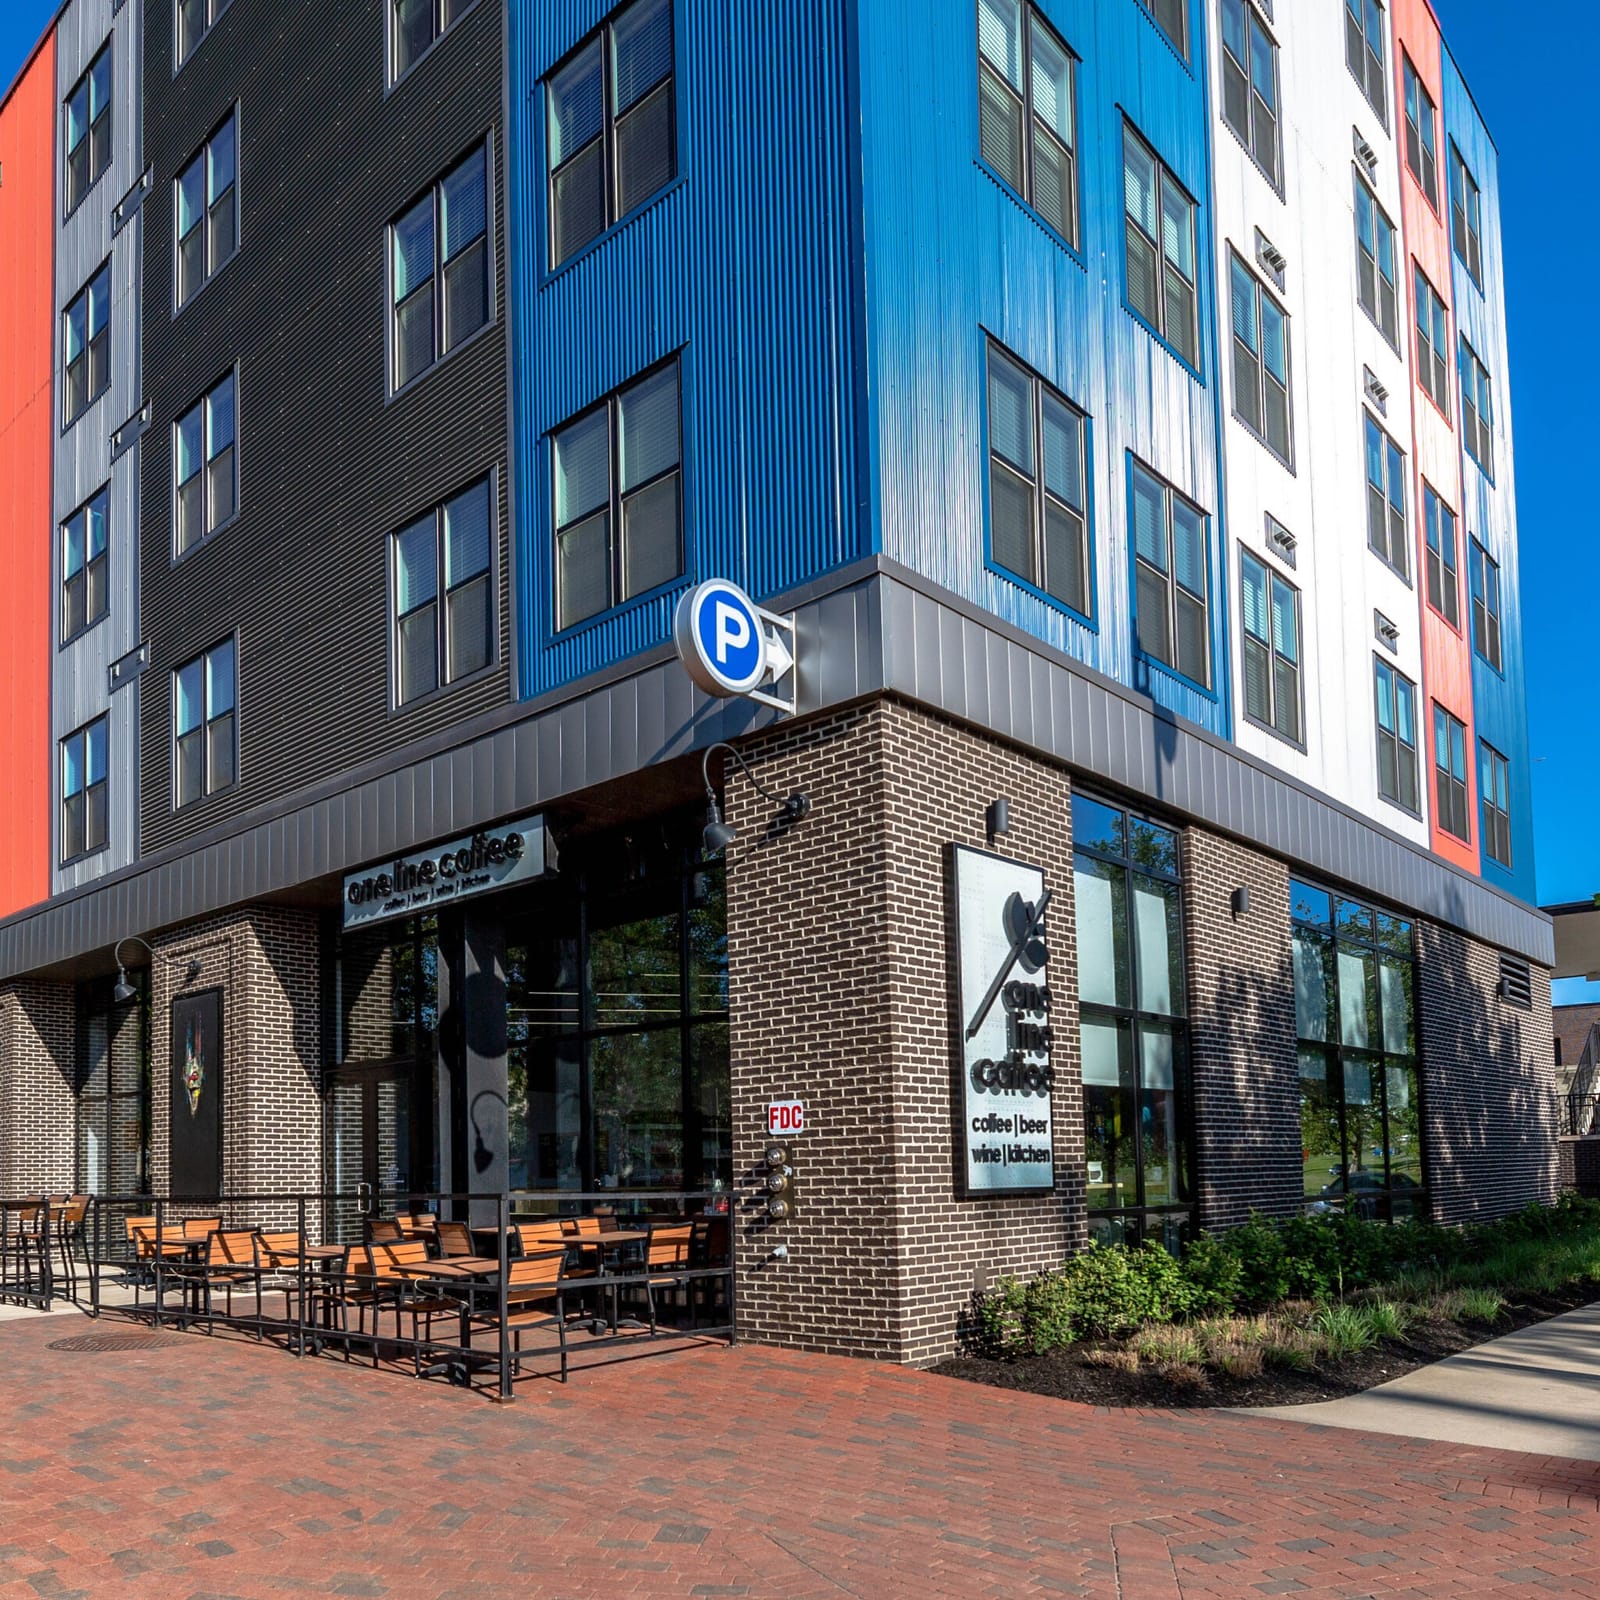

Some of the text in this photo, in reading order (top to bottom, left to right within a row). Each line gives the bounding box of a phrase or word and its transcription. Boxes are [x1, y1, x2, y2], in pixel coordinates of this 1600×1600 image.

[716, 600, 750, 664] P
[439, 832, 525, 878] coffee
[1002, 980, 1051, 1014] one
[971, 1052, 1055, 1093] coffee
[769, 1105, 803, 1130] FDC
